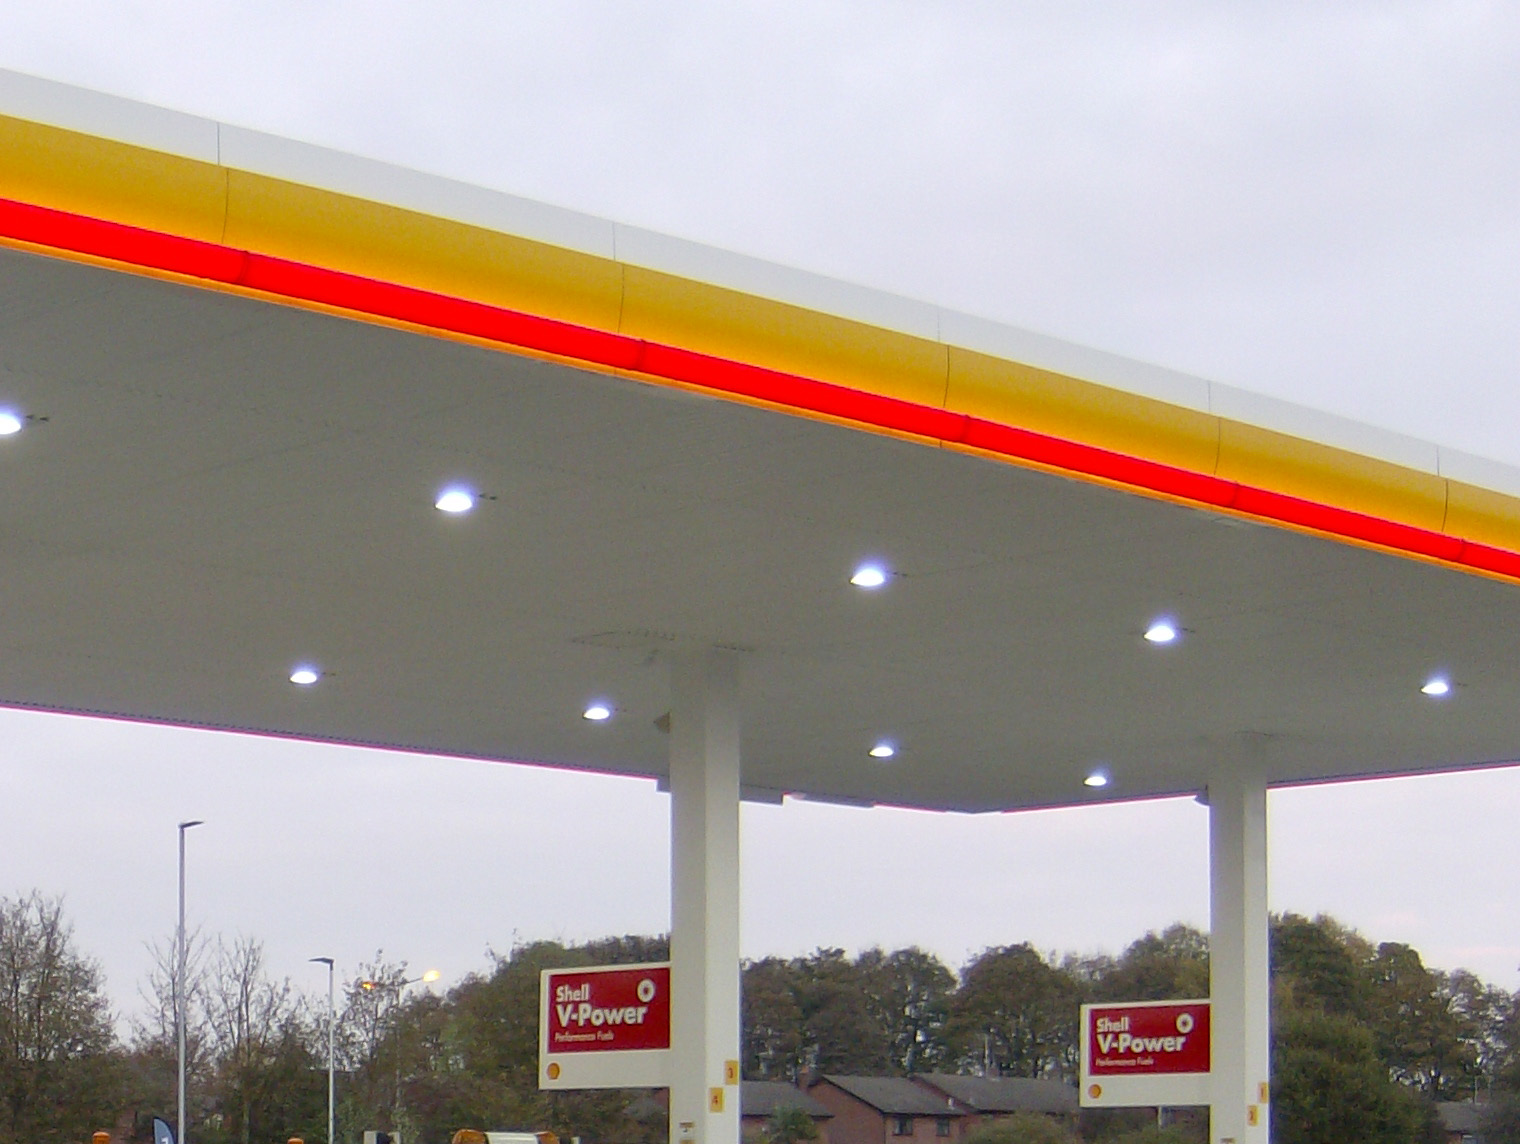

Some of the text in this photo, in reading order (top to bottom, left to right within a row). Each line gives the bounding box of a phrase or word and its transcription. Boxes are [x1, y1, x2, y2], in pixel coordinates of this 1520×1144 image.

[556, 983, 589, 1003] Shell
[556, 1003, 648, 1028] V-Power
[1096, 1016, 1130, 1034] Shell
[1096, 1033, 1187, 1055] V-Power
